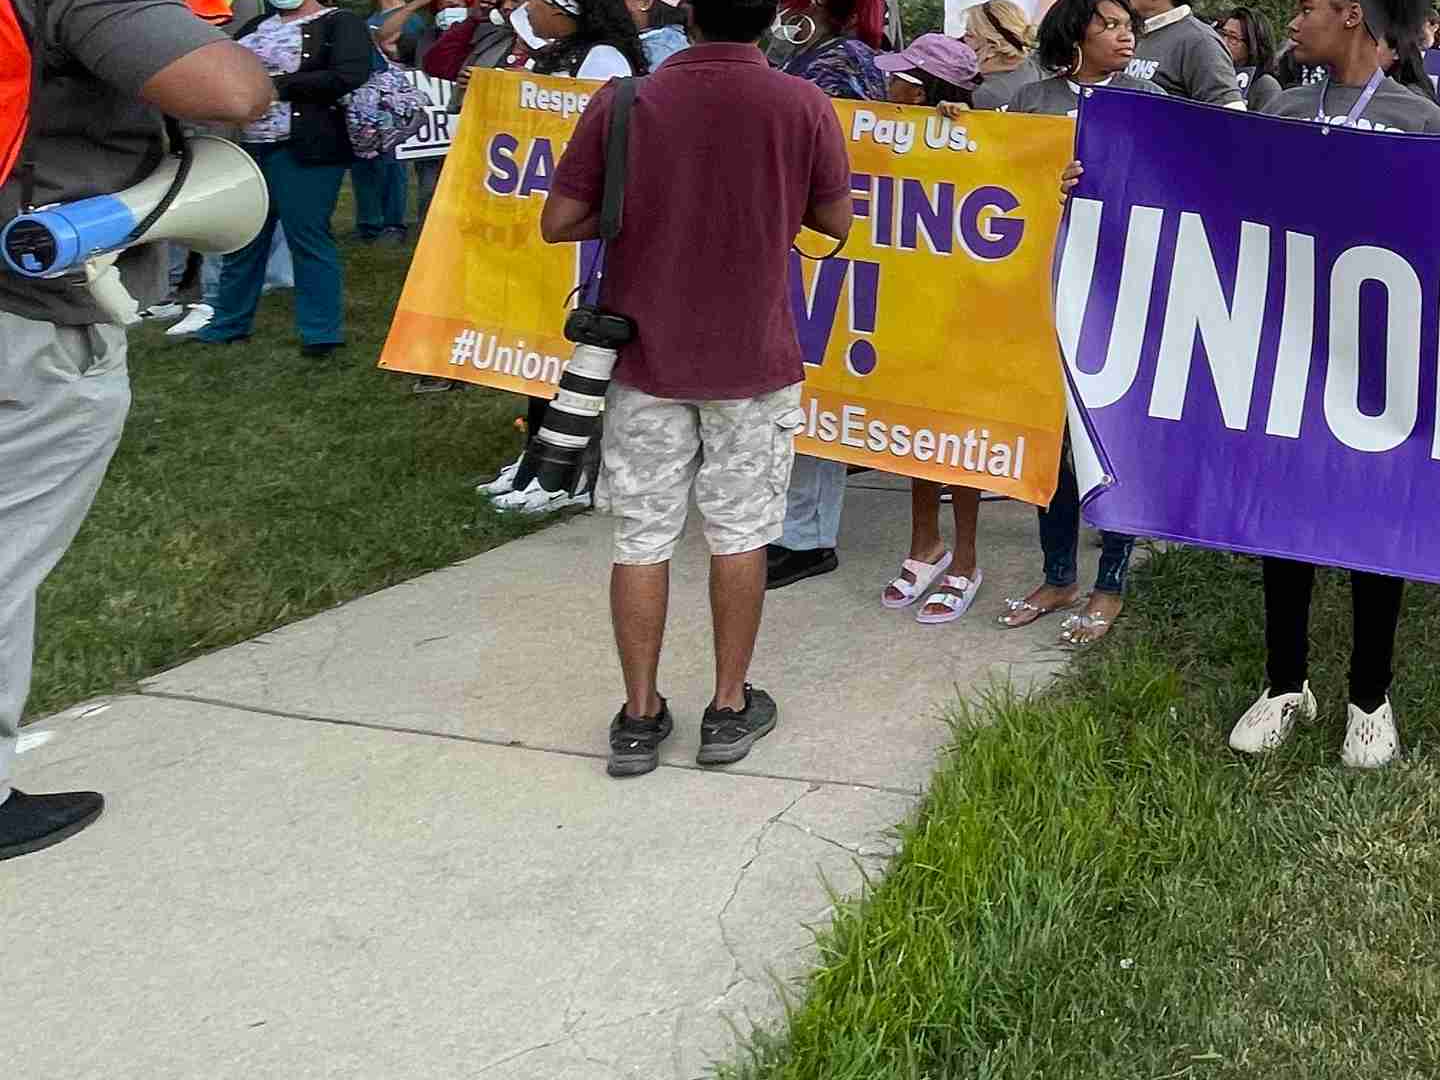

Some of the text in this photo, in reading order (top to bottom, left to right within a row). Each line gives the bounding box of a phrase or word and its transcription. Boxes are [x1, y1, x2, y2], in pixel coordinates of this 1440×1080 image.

[520, 81, 977, 154] Respe Pay Us.
[484, 131, 558, 199] SA
[449, 328, 565, 386] #Union
